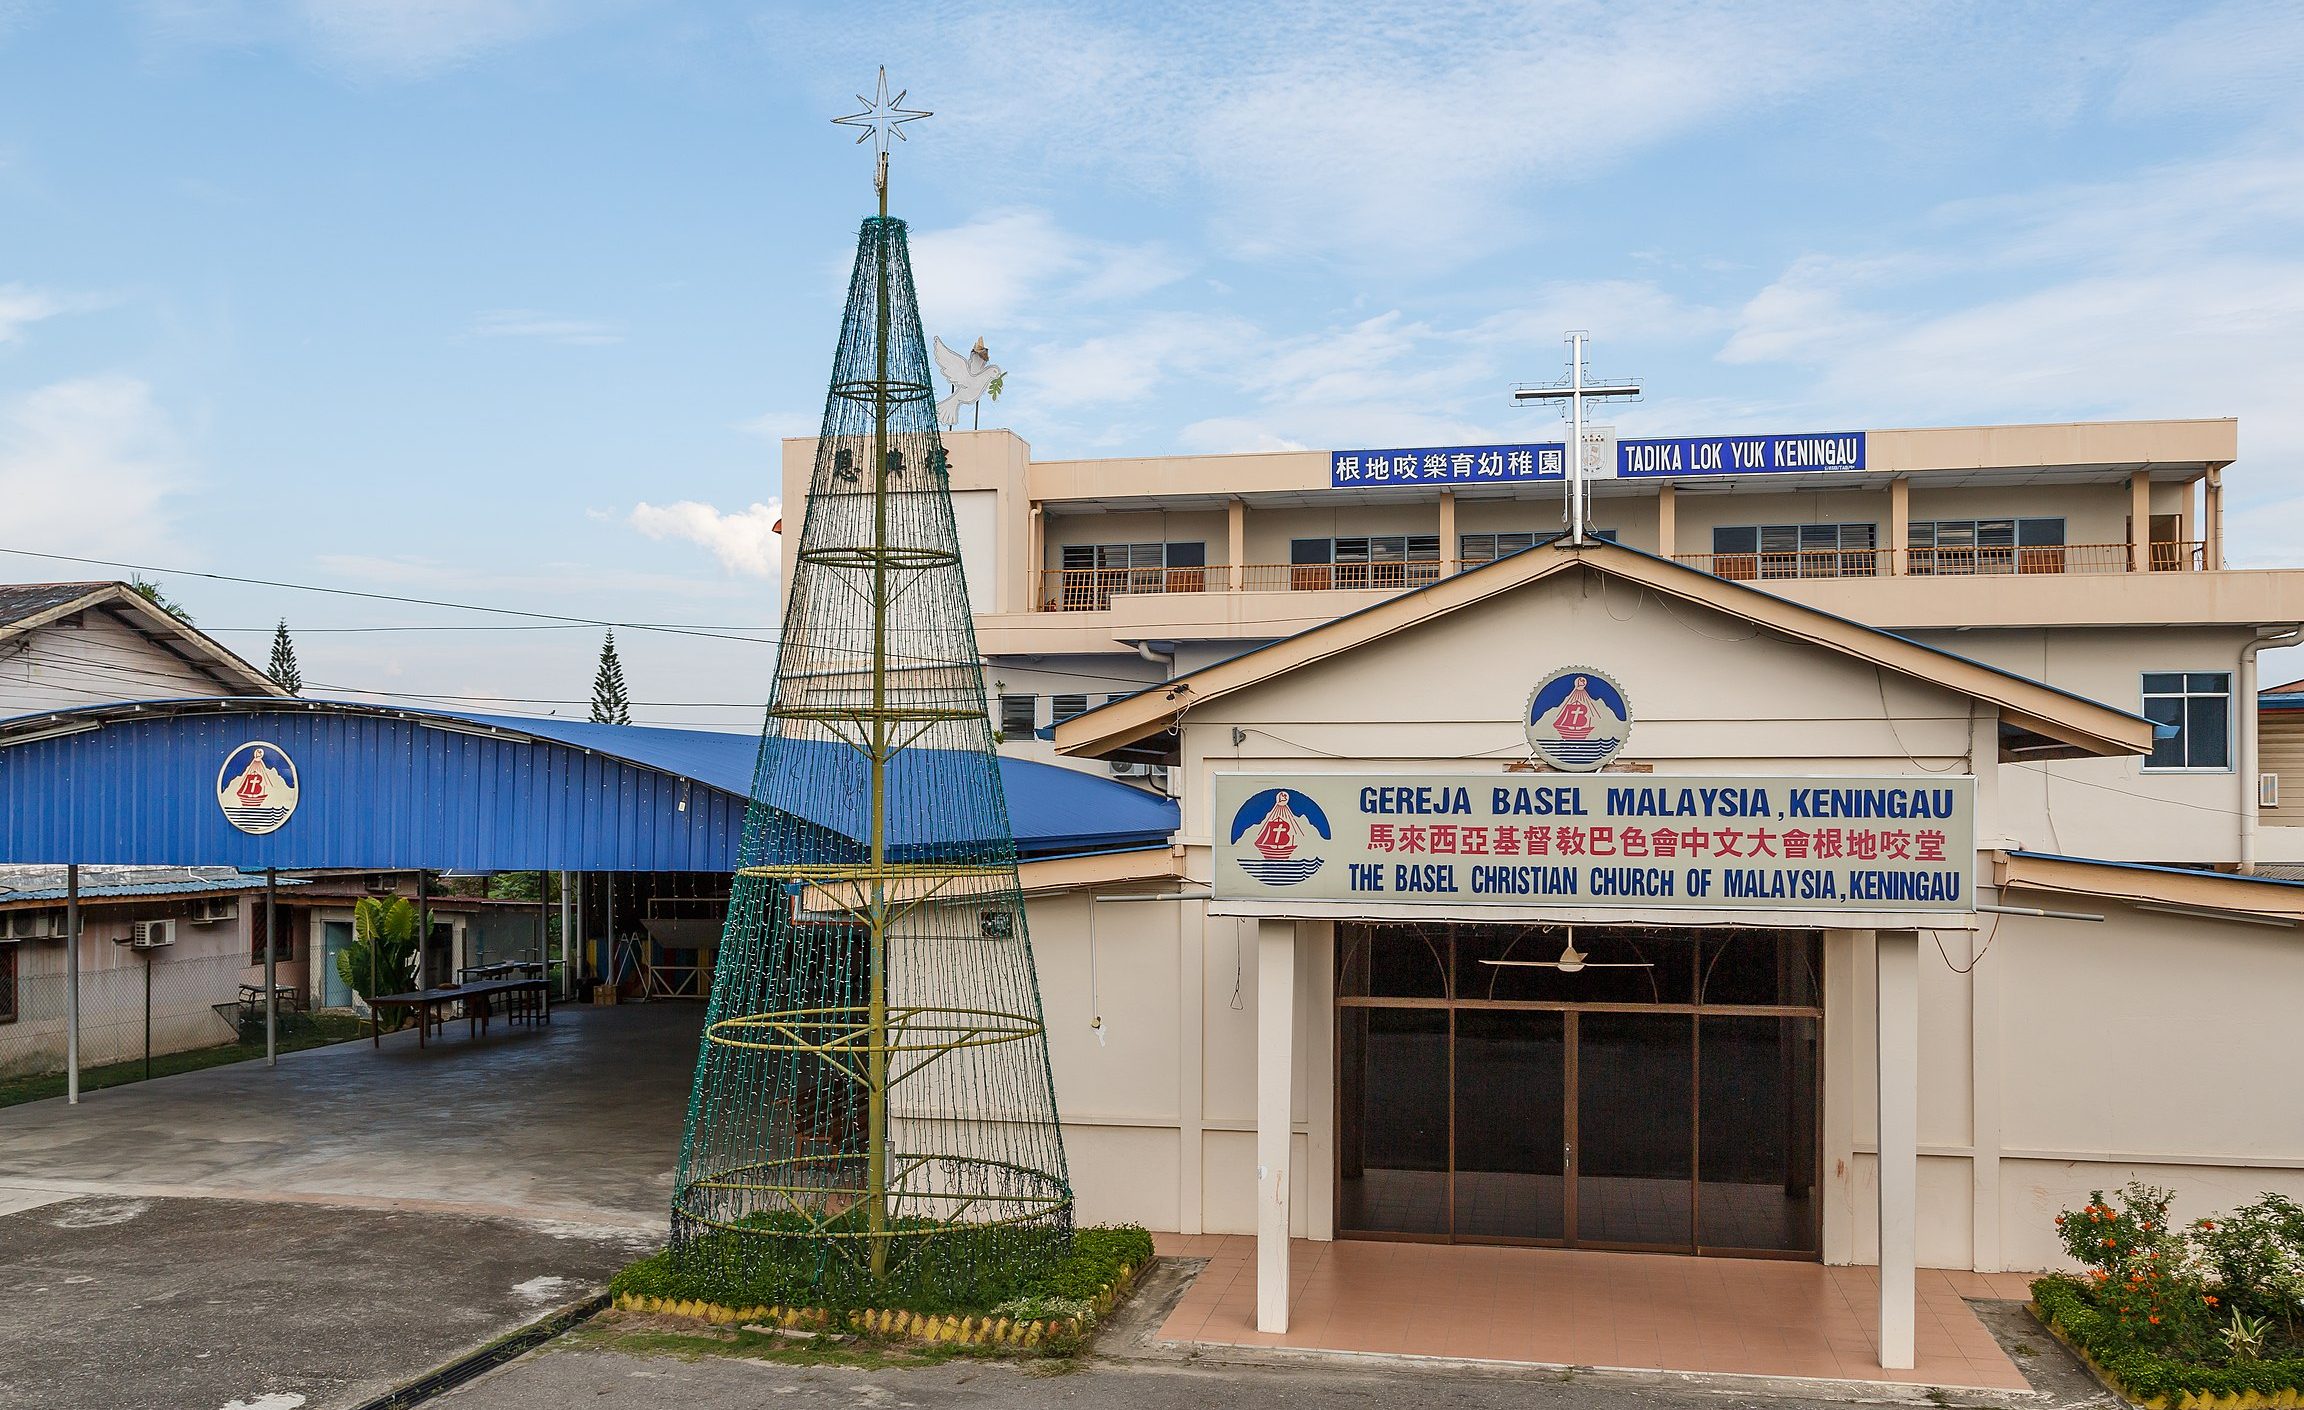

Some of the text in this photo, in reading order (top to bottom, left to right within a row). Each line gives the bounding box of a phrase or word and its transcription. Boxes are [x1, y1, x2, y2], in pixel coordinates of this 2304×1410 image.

[1336, 450, 1563, 481] 根地咬樂育幼稚園
[1625, 437, 1858, 472] TADIKA LOK YUK KENINGAU
[1359, 786, 1473, 815] GEREJA
[1491, 787, 1588, 816] BASEL
[1348, 863, 1384, 891] THE
[1395, 864, 1459, 893] BASEL
[1471, 866, 1578, 895] CHRISTIAN
[1590, 867, 1675, 897] CHURCH
[1686, 868, 1712, 897] OF
